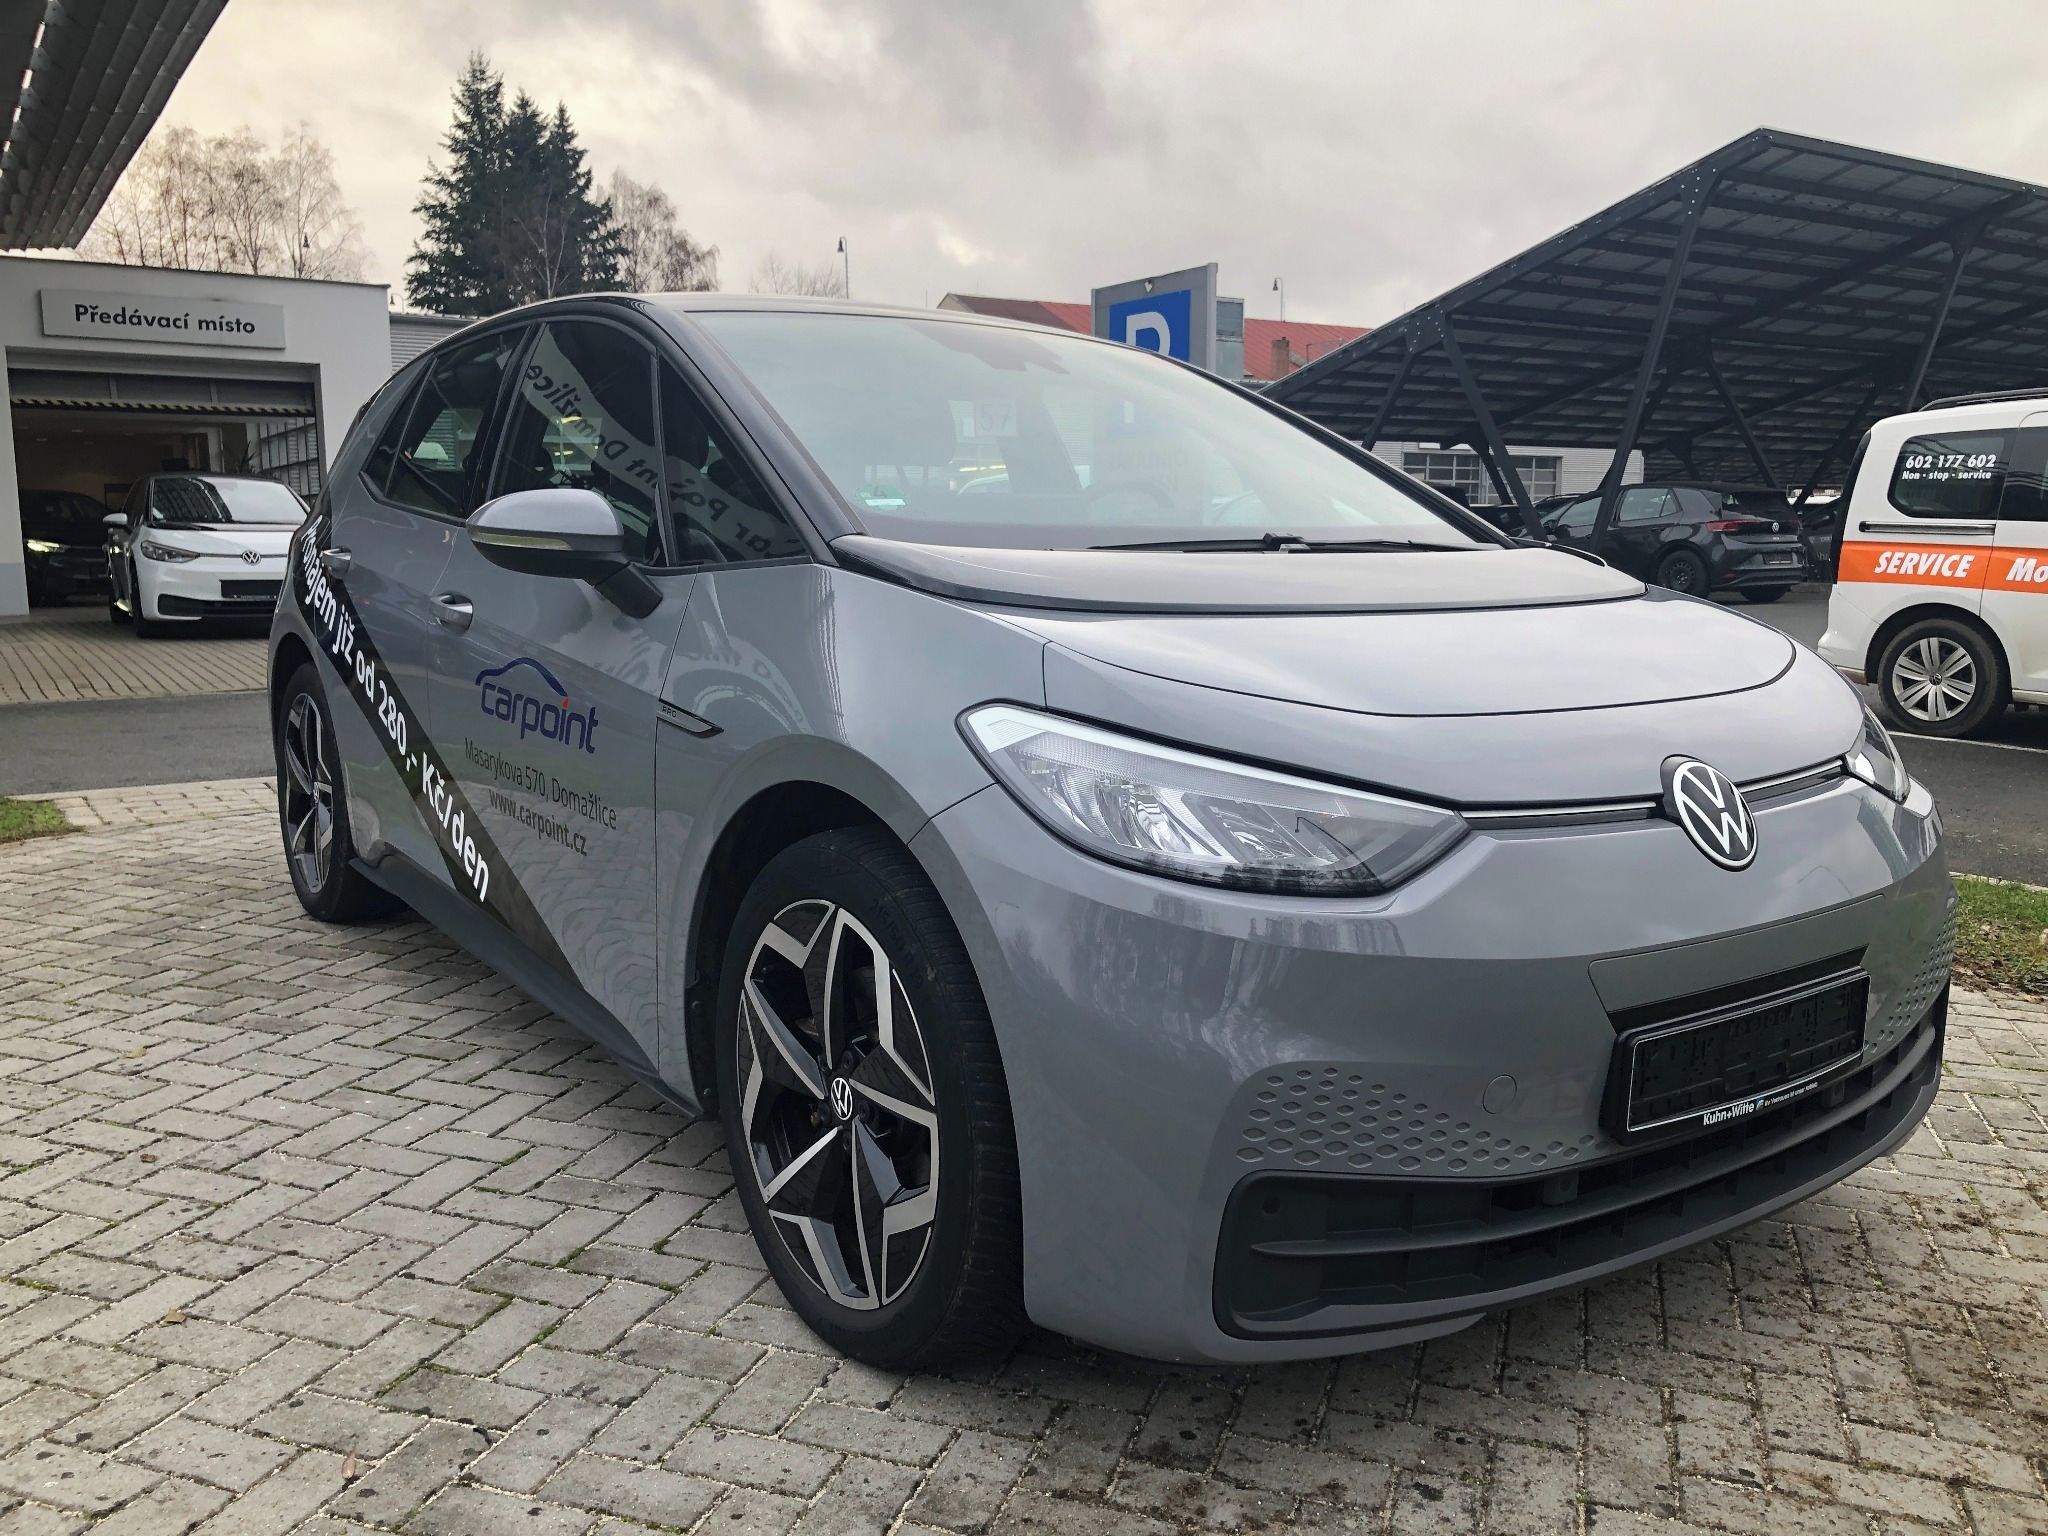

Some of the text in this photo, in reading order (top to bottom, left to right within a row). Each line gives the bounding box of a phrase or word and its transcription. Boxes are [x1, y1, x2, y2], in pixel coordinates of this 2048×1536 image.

[74, 303, 256, 334] Předávací místo
[1902, 470, 1920, 480] Non
[1928, 470, 1949, 482] stop
[1957, 469, 1992, 480] service
[1905, 454, 1997, 469] 602 177 602
[1873, 551, 1976, 578] SERVICE
[333, 604, 356, 666] již
[356, 650, 375, 704] od
[481, 682, 599, 755] carpoint
[465, 737, 617, 831] Masarykova 570, Domažlice
[489, 788, 588, 857] www.carpoint.cz
[1703, 1102, 1755, 1126] Kuhn+Witte
